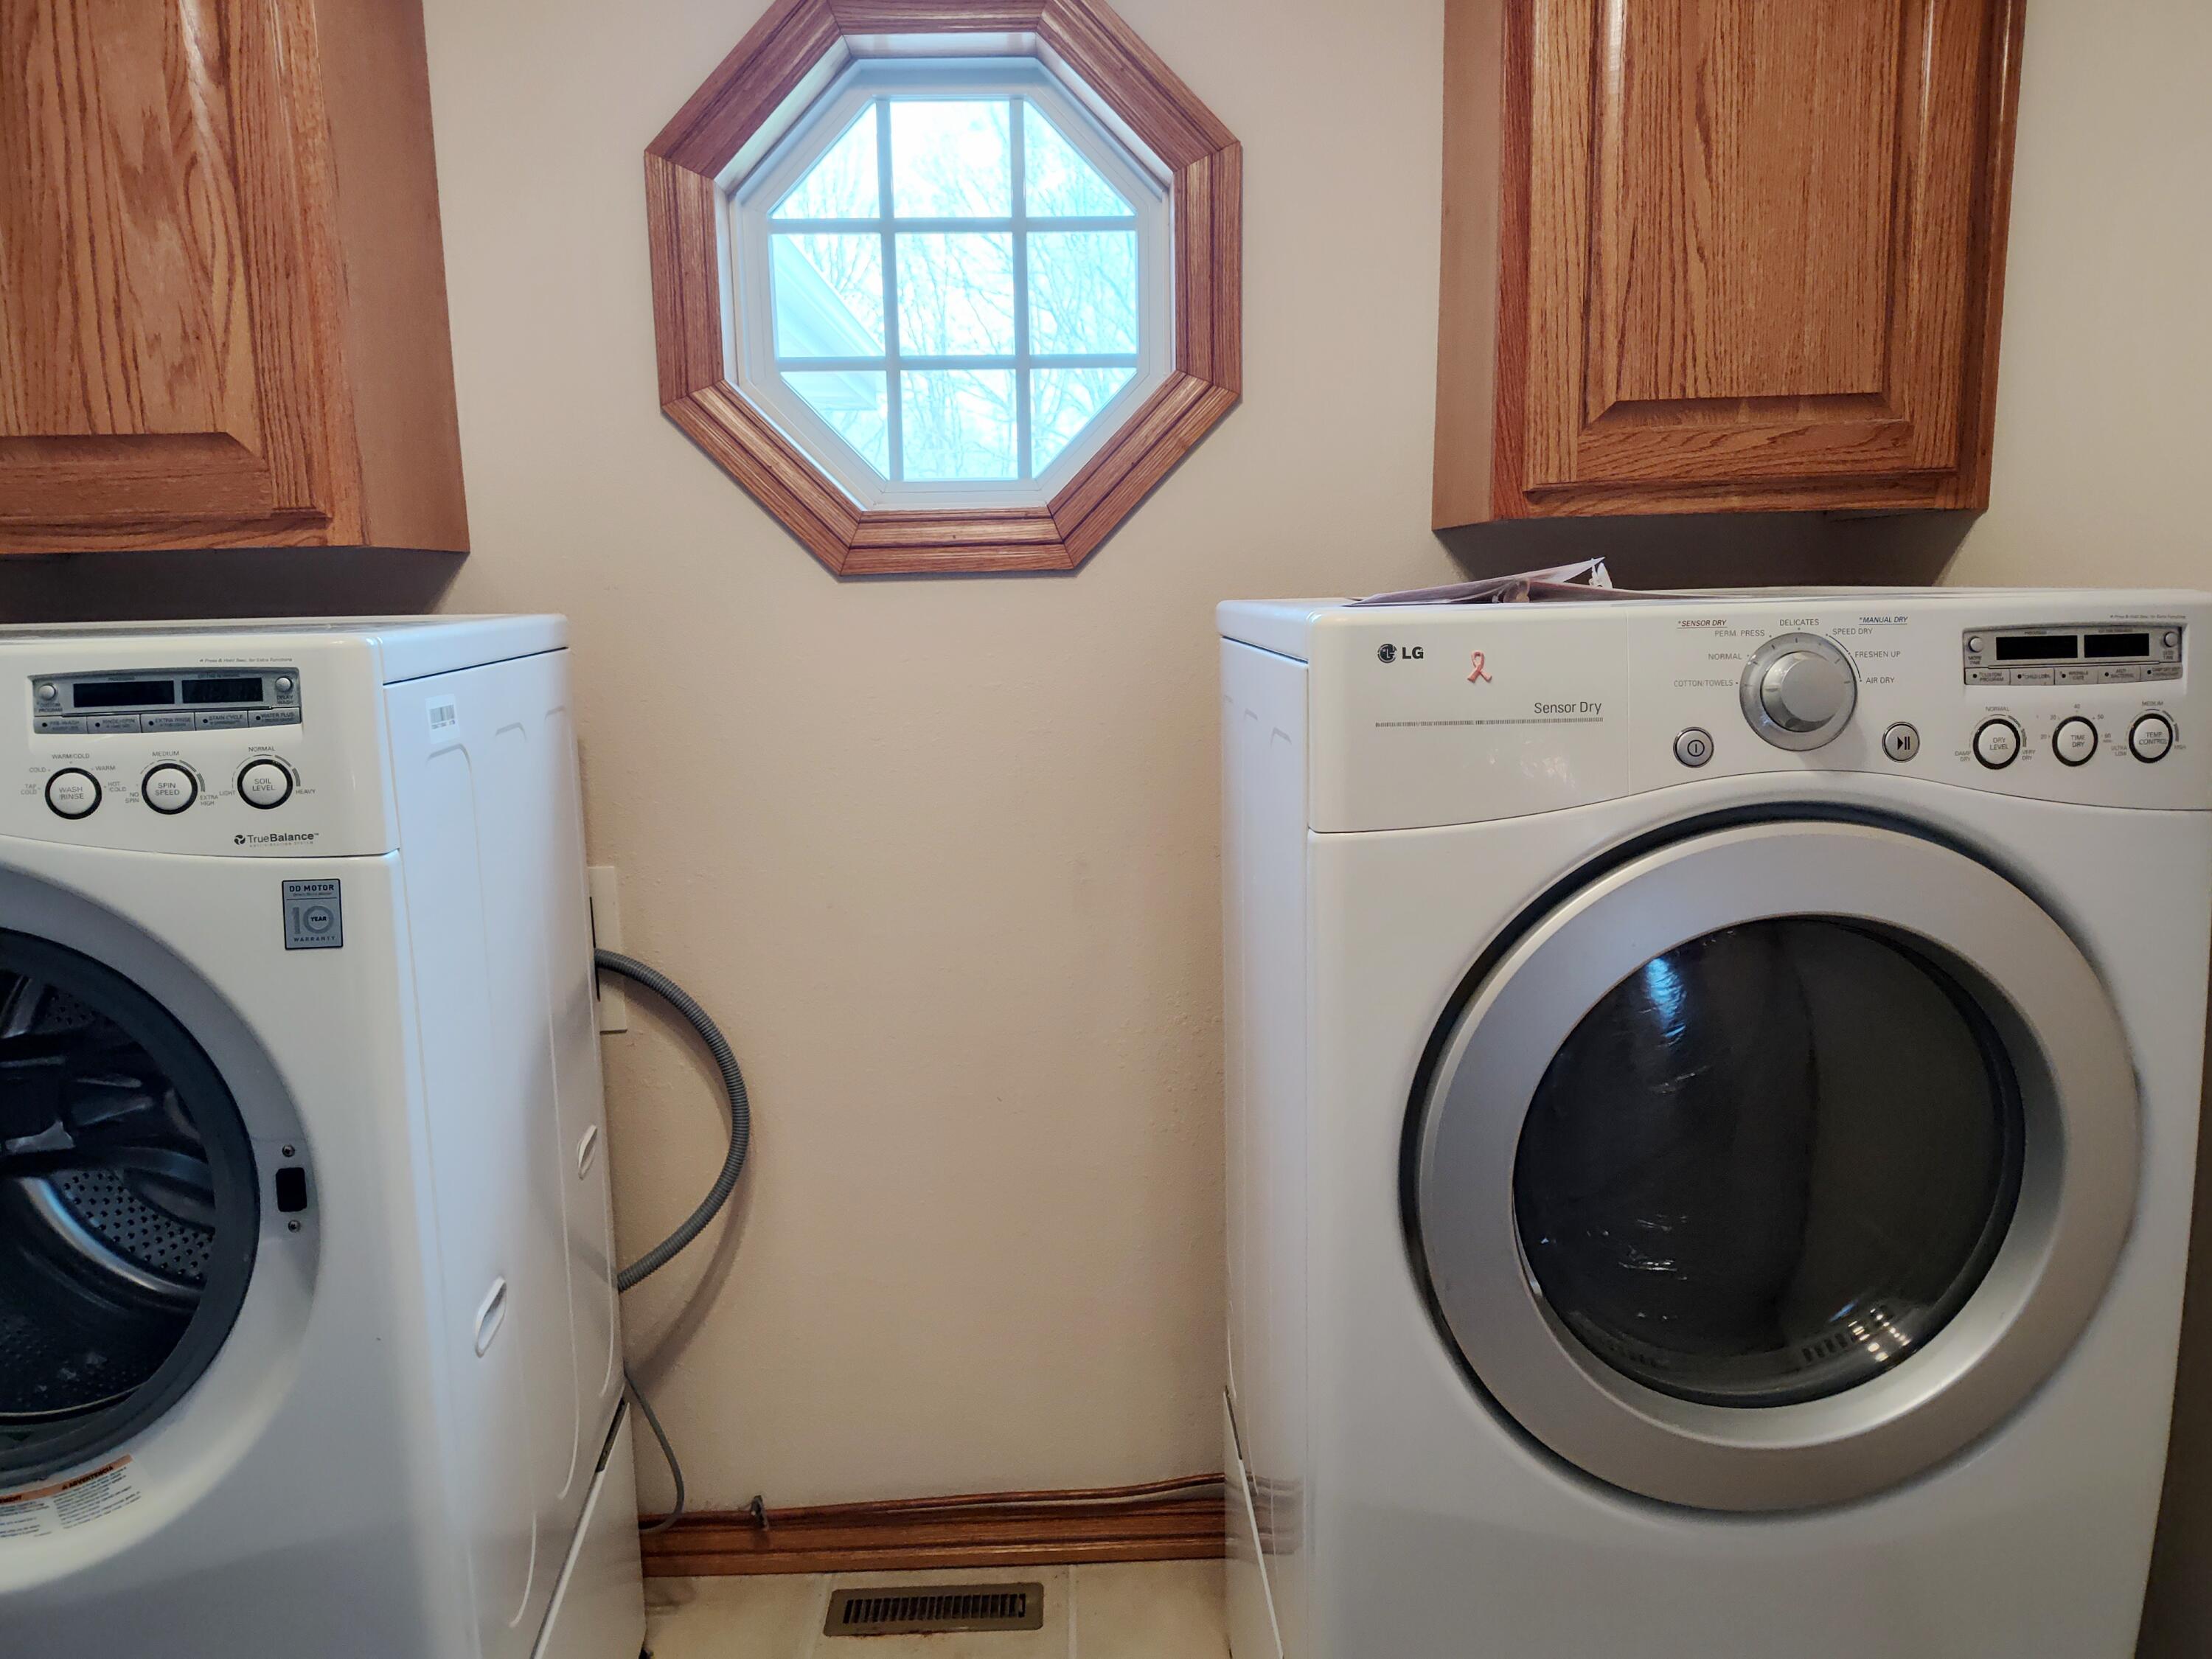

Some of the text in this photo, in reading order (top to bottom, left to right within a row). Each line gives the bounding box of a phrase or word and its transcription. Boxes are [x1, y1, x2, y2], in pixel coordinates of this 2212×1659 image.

[1402, 646, 1424, 659] LG
[1534, 701, 1602, 714] Sensor Dry
[291, 905, 334, 934] 10
[69, 1465, 114, 1488] ADVERTENCIA
